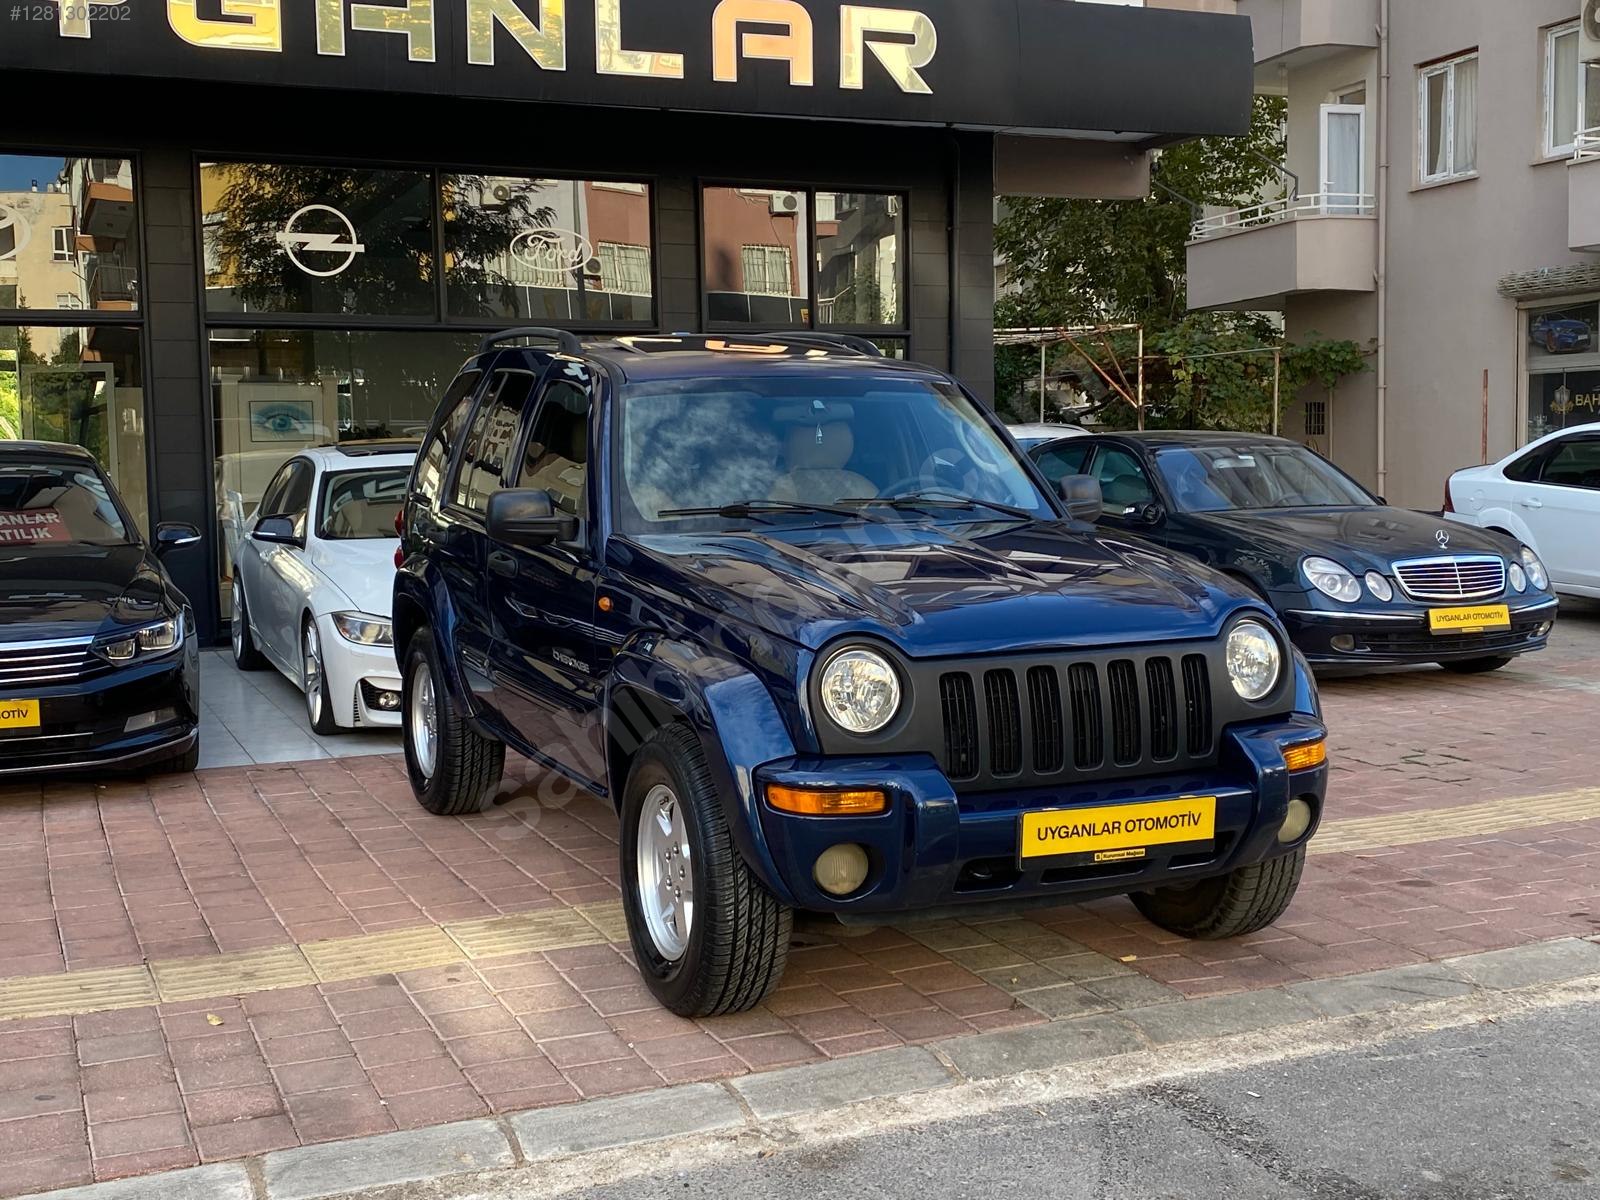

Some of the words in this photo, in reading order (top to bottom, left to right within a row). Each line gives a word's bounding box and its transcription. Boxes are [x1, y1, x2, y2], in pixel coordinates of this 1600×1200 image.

[525, 235, 583, 261] Ford
[1436, 613, 1472, 623] UYGANLAR
[0, 707, 28, 720] OTİV
[1037, 821, 1121, 841] UYGANLAR
[1124, 810, 1202, 832] OTOMOTİV
